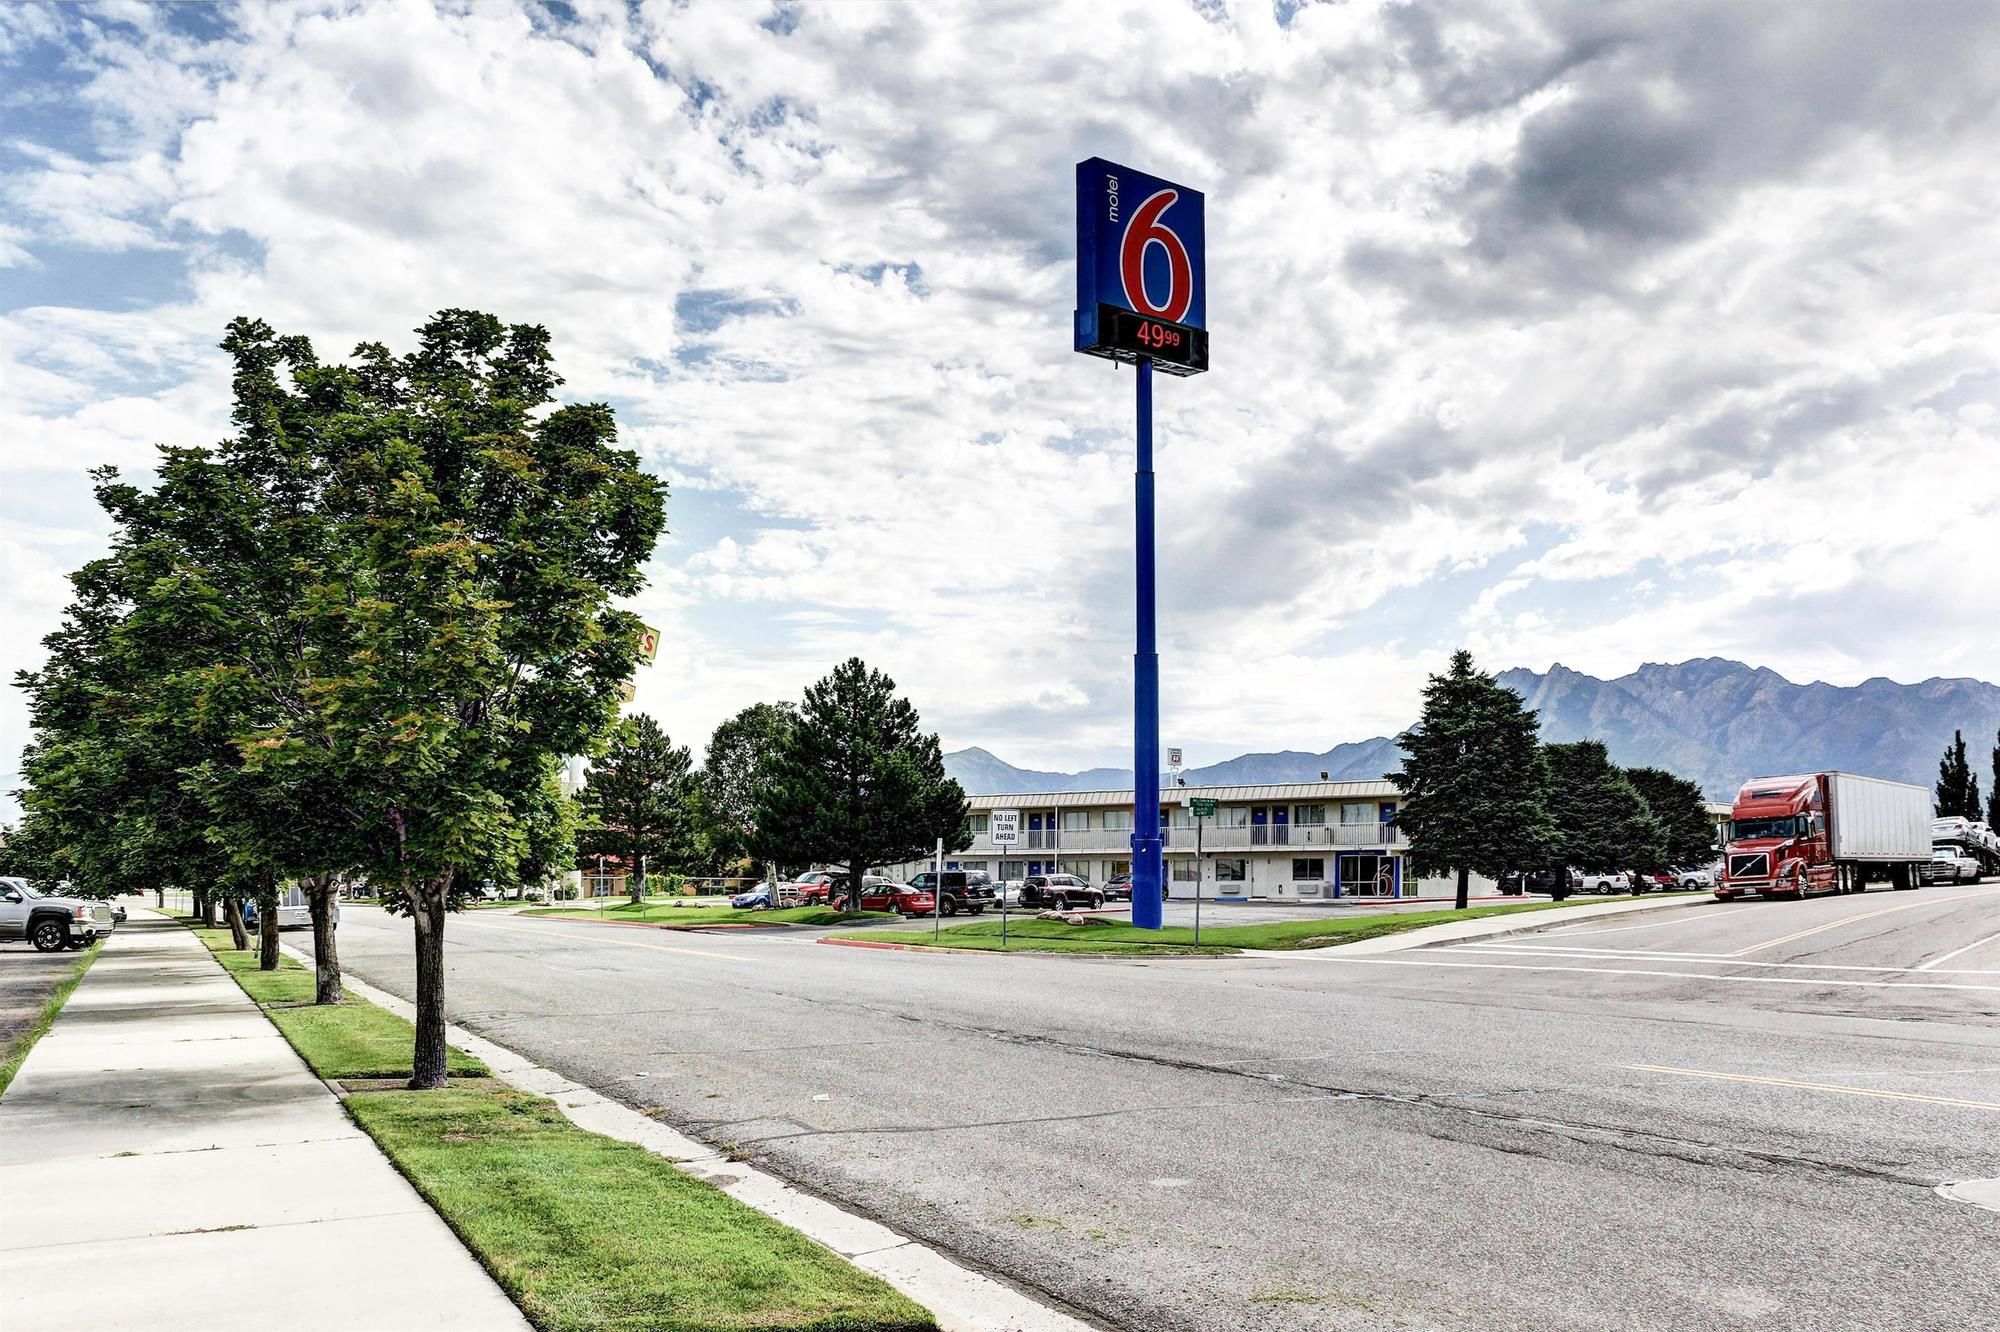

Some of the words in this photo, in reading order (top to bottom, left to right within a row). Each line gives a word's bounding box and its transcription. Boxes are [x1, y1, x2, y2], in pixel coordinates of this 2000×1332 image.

[1106, 174, 1119, 223] motel
[1119, 188, 1193, 323] 6
[993, 814, 1003, 822] NO
[1004, 814, 1017, 822] LEFT
[997, 823, 1014, 831] TURN
[995, 833, 1016, 841] AHEAD
